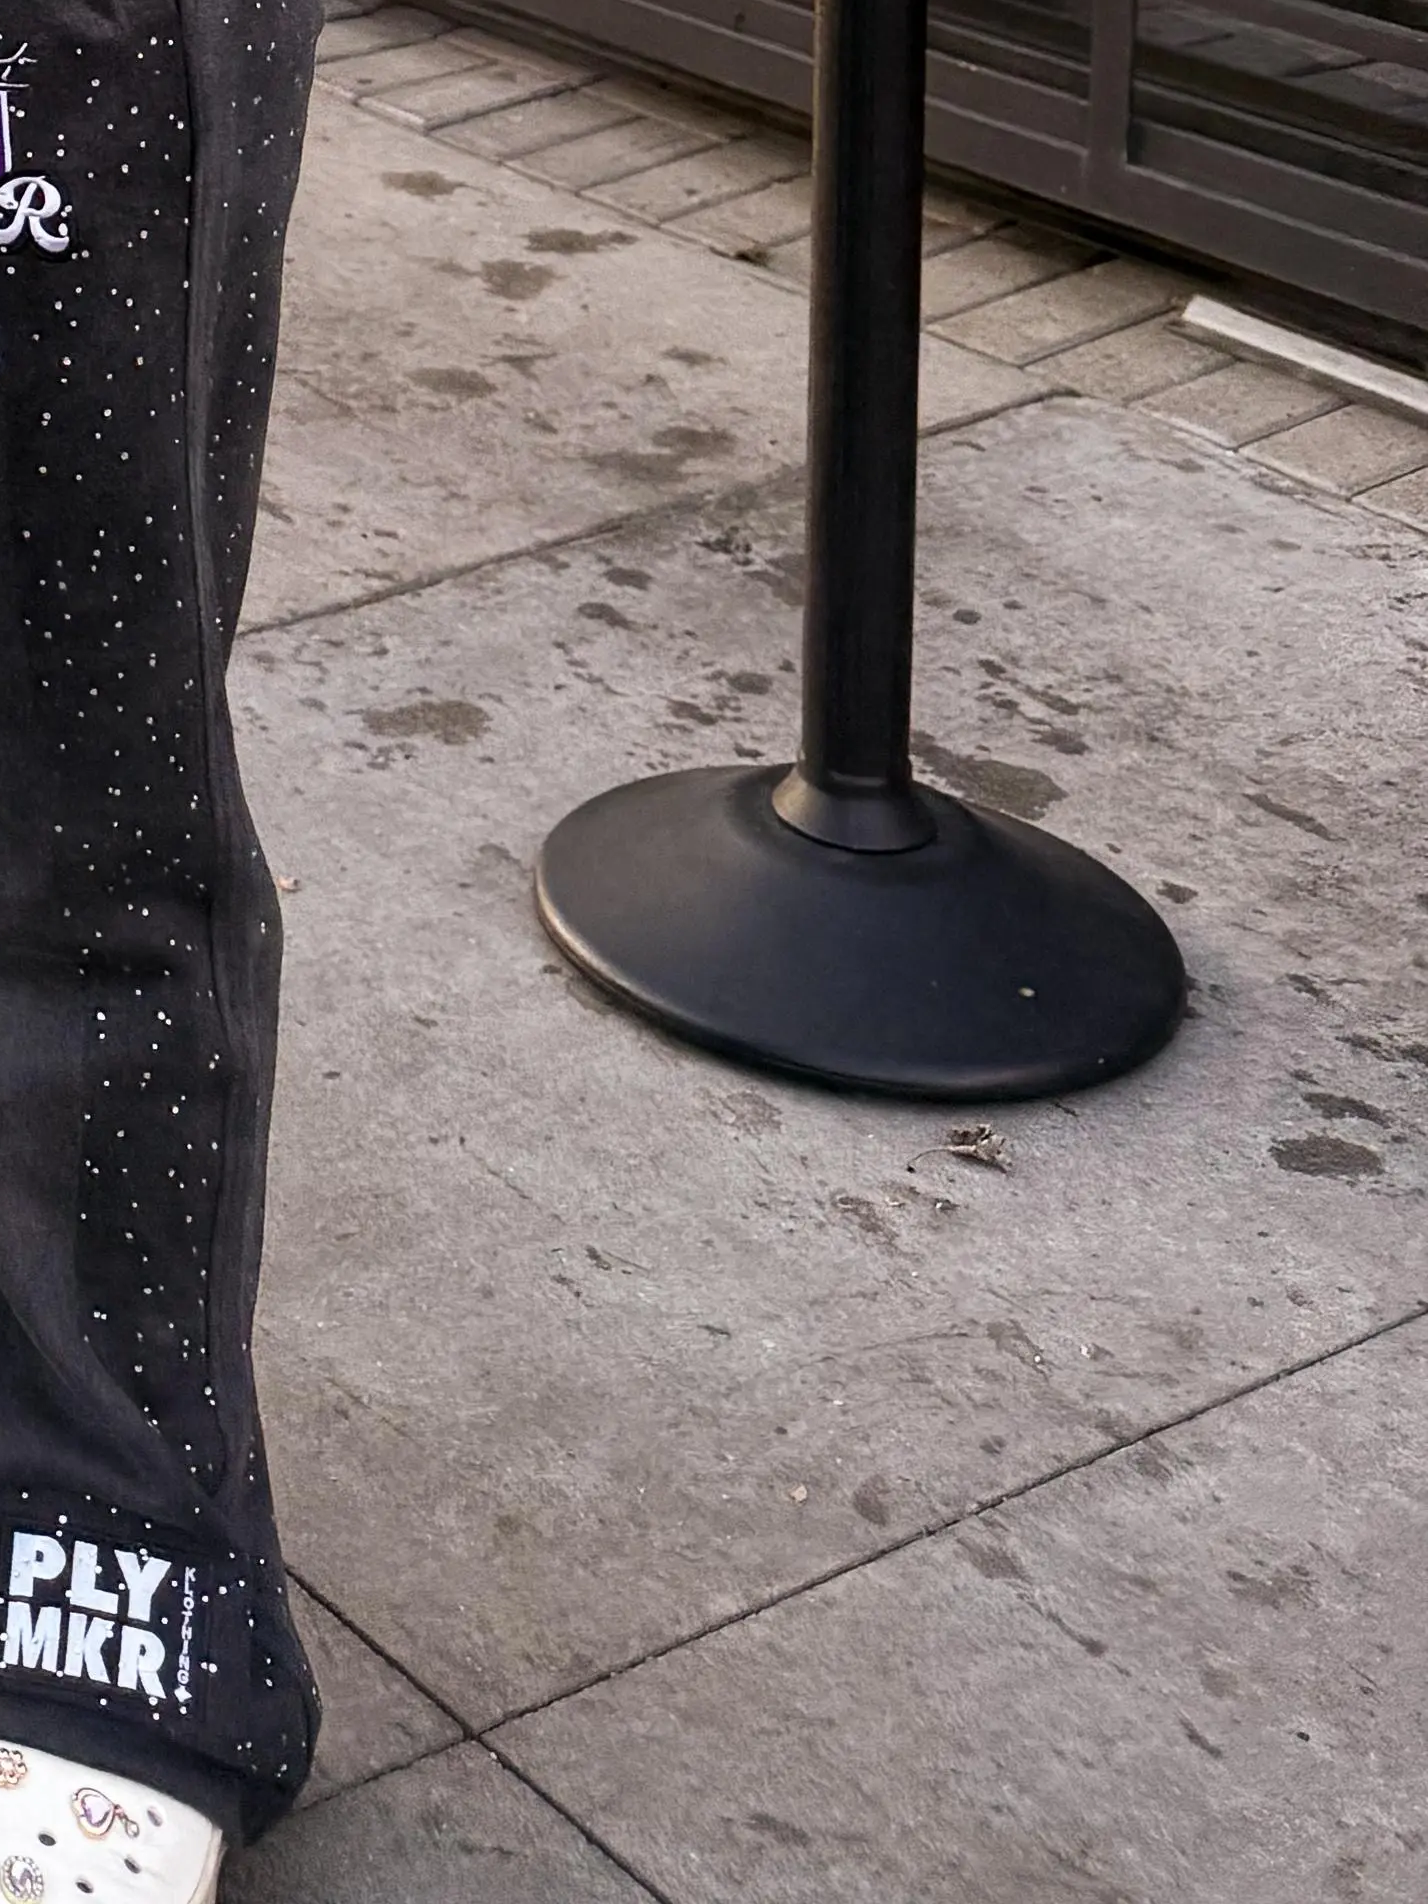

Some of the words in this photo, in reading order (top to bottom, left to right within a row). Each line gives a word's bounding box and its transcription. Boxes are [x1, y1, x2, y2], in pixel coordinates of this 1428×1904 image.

[8, 1531, 172, 1622] PLY
[176, 1565, 197, 1685] KLOTHING
[1, 1601, 167, 1700] MKR
